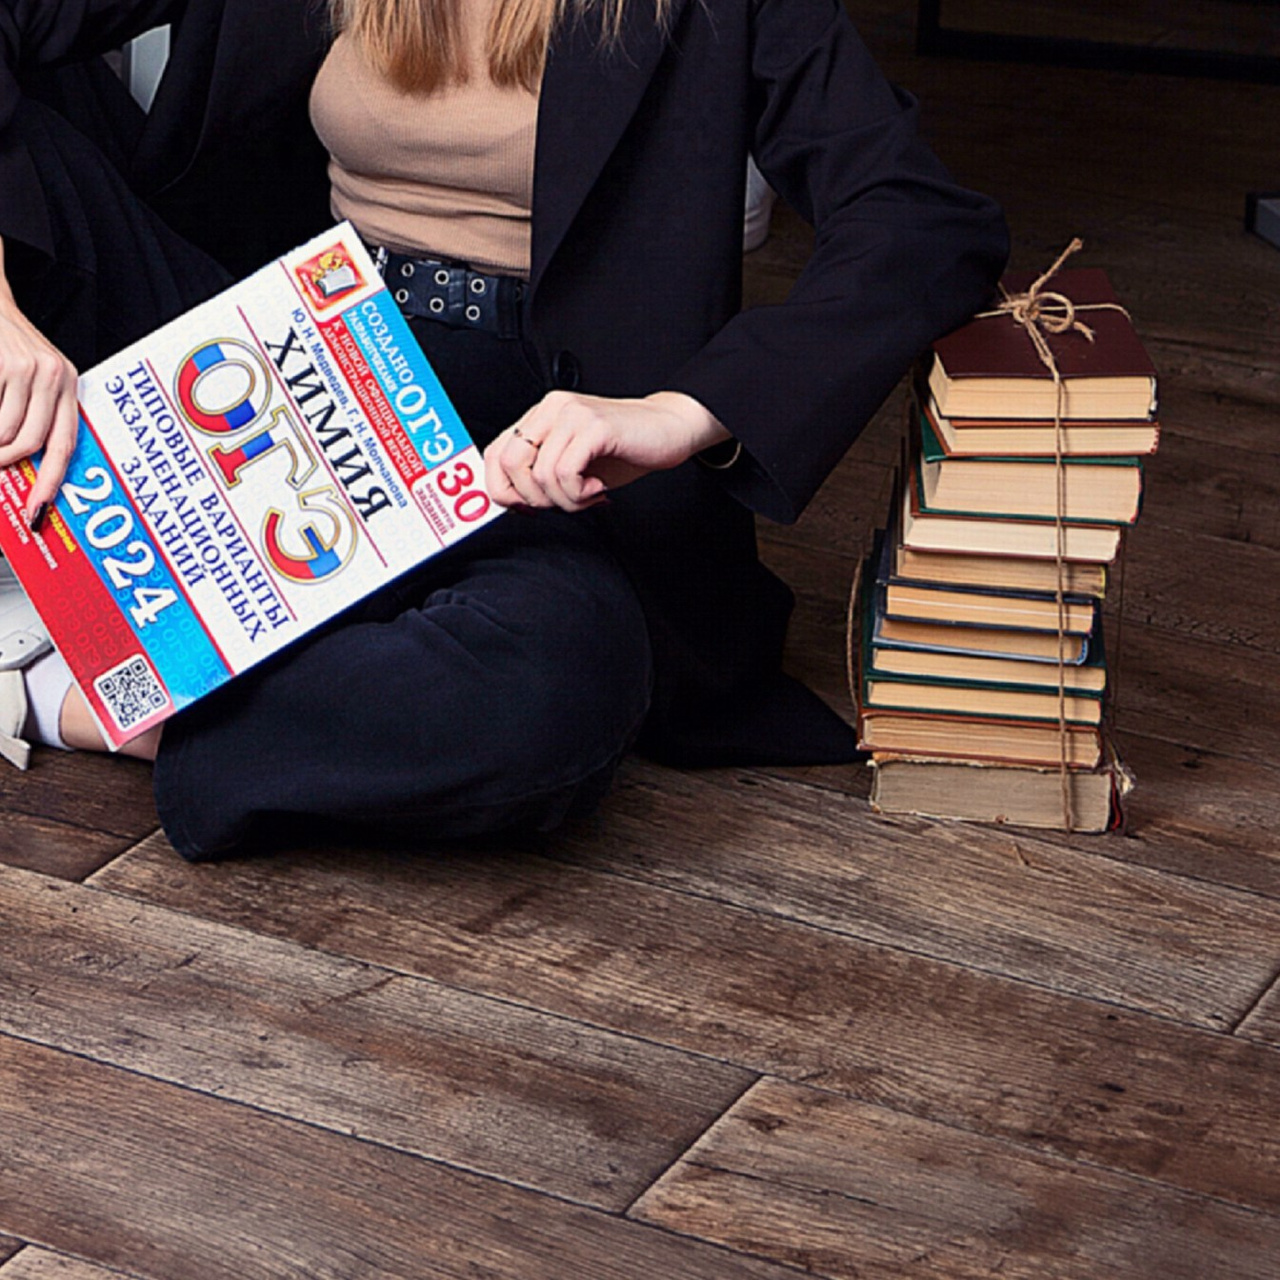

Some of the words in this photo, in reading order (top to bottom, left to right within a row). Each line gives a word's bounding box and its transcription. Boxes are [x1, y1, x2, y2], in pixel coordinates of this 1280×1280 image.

[289, 306, 310, 330] Ю.
[299, 324, 319, 346] Н.
[309, 341, 349, 410] Медведев,
[360, 299, 414, 384] СОЗДАНО
[394, 383, 454, 463] ОГЭ
[172, 339, 357, 583] ОГЭ
[263, 326, 393, 522] ХИМИЯ
[321, 326, 391, 439] ДЕМОНСТРАЦИОННОЙ
[385, 437, 413, 479] ВЕРСИИ
[330, 318, 343, 332] К
[338, 332, 370, 377] НОВОЙ
[364, 378, 425, 474] ОФИЦИАЛЬНОЙ
[344, 406, 362, 424] Г.
[352, 419, 371, 440] Н.
[104, 374, 267, 643] ЭКЗАМЕНАЦИОННЫХ
[120, 455, 208, 588] ЗАДАНИЙ
[126, 360, 205, 486] ТИПОВЫЕ
[198, 491, 290, 630] ВАРИАНТЫ
[361, 435, 408, 509] Молчанова
[414, 487, 448, 536] заданий
[435, 461, 491, 523] 30
[56, 465, 178, 628] 2024
